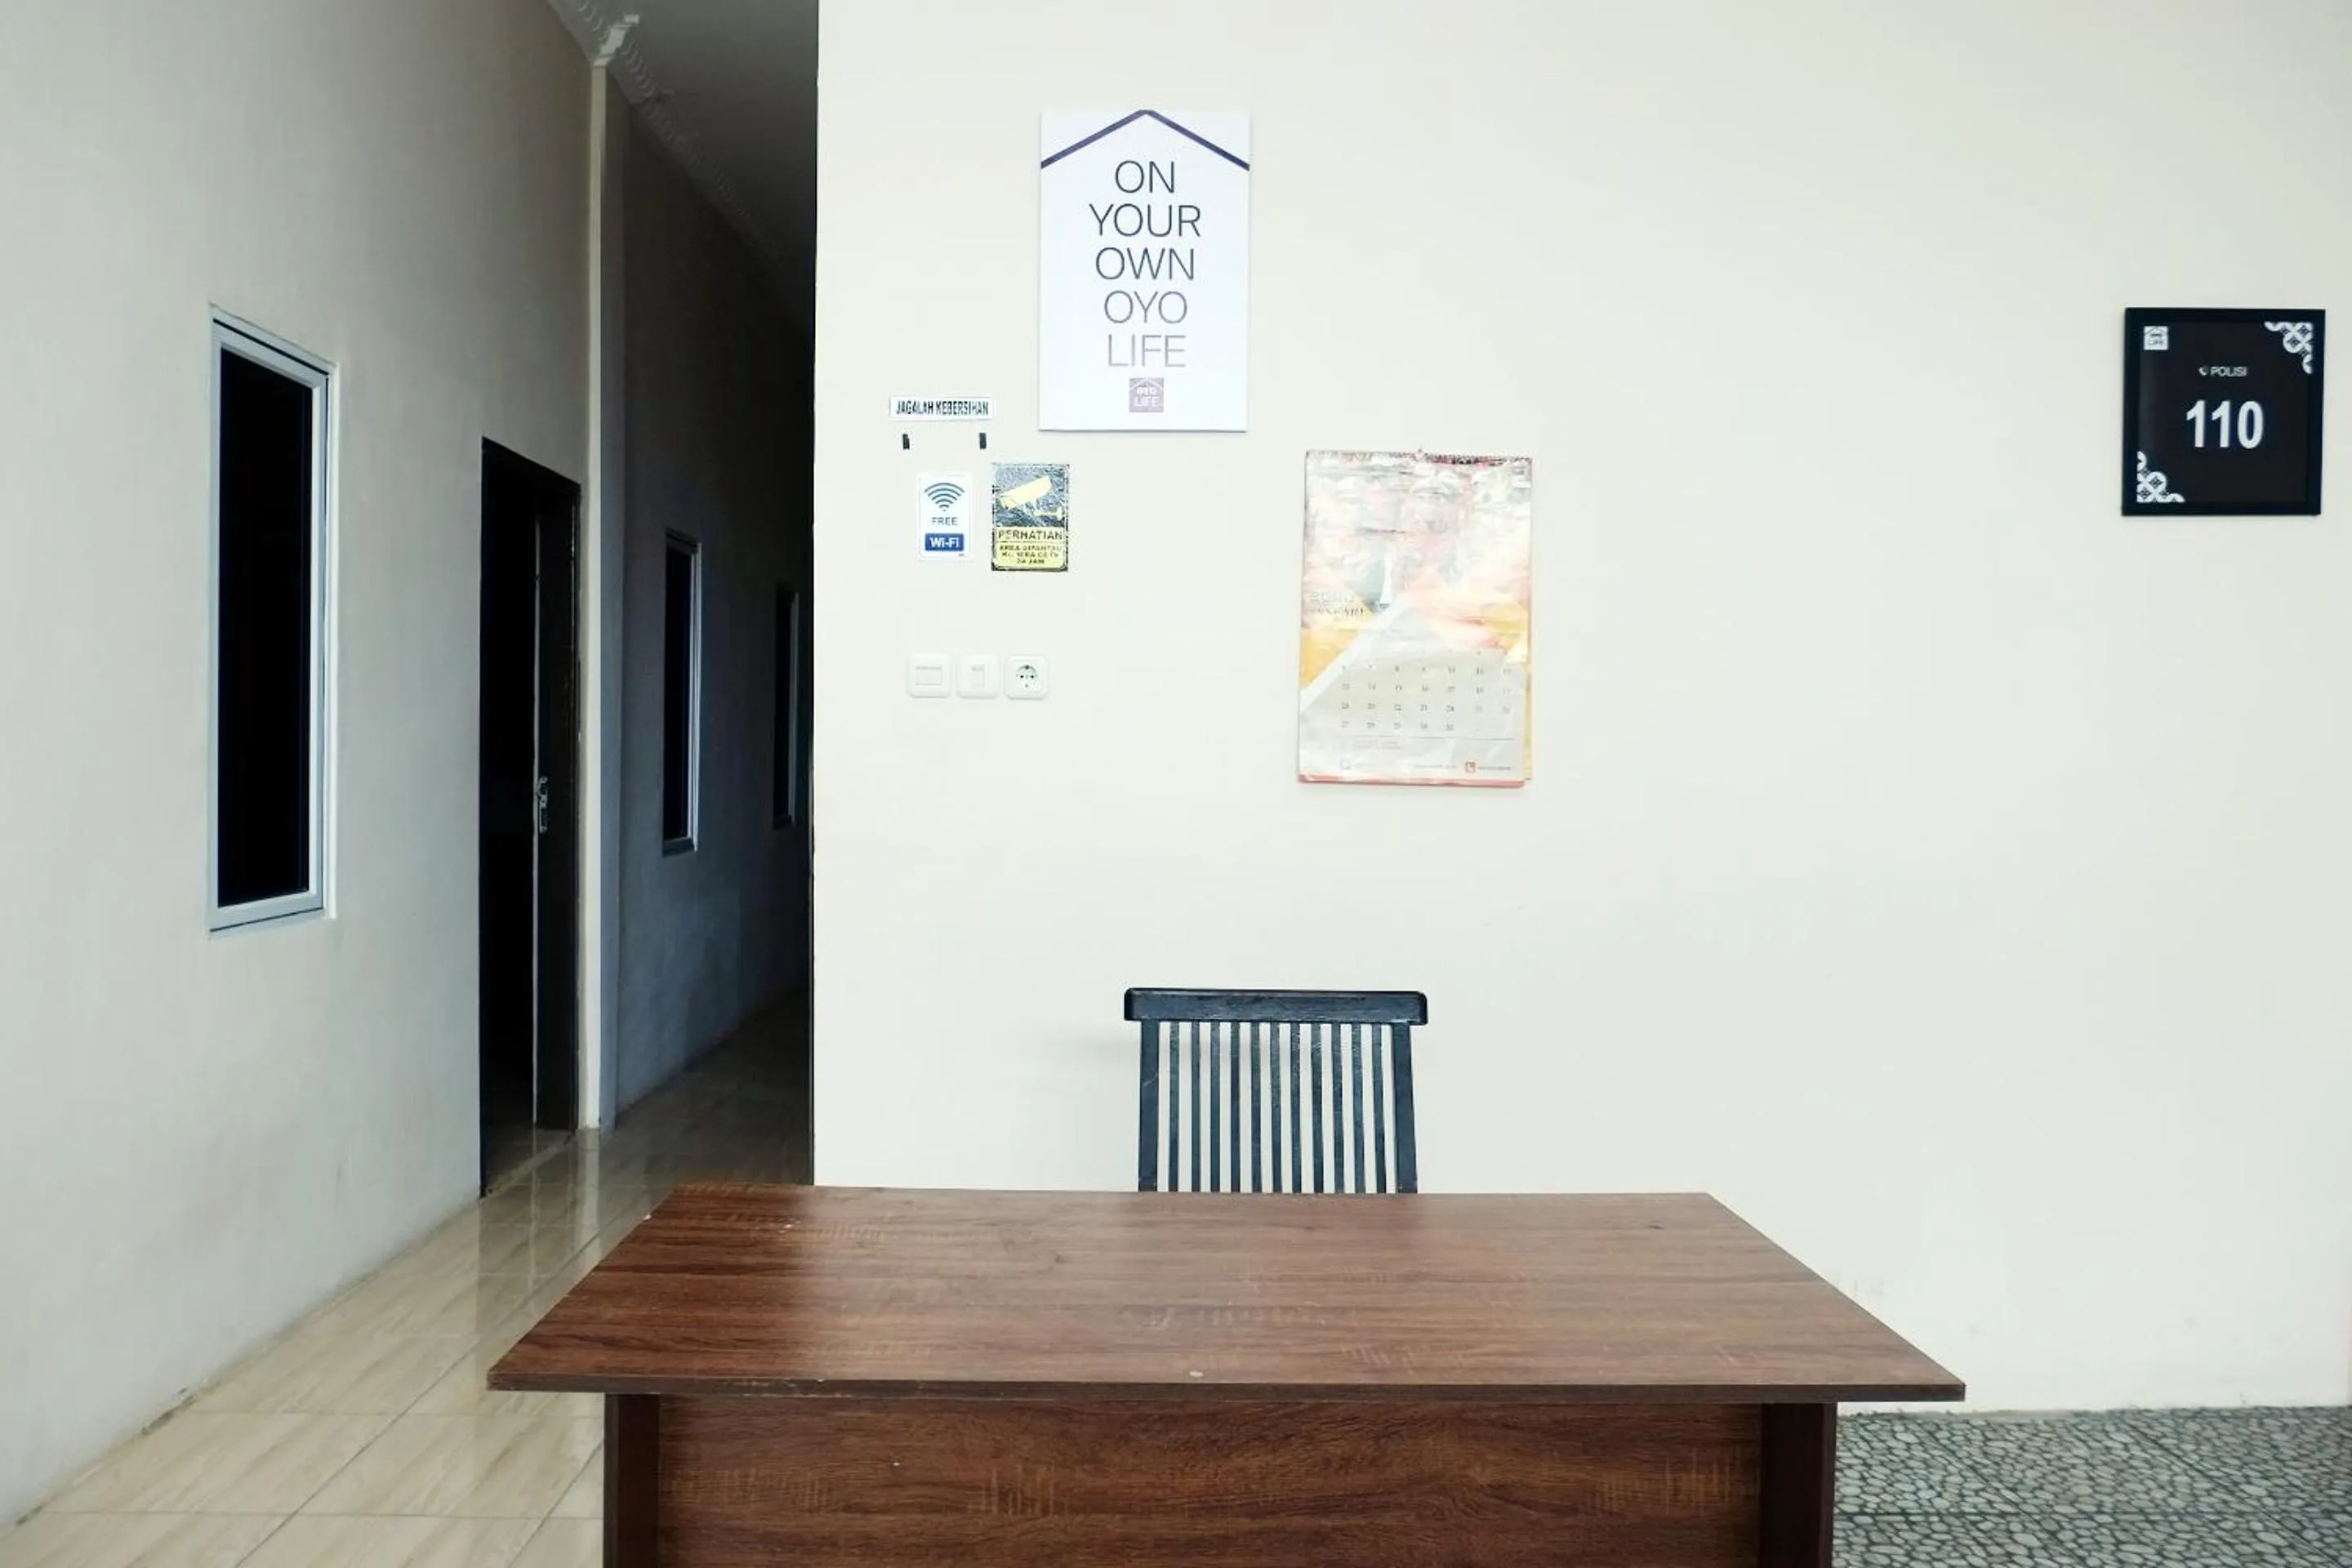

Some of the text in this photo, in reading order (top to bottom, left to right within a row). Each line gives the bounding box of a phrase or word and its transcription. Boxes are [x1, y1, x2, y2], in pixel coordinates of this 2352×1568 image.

[1115, 160, 1174, 194] ON
[1089, 203, 1200, 237] YOUR
[1095, 247, 1194, 280] OWN
[1104, 290, 1187, 323] OYO
[1107, 334, 1186, 367] LIFE
[2210, 366, 2247, 377] POLISI
[897, 400, 989, 416] JAGALAH KEBERSIHAN
[2186, 399, 2264, 449] 110
[931, 516, 959, 526] FREE
[998, 529, 1062, 540] PERHATIAN
